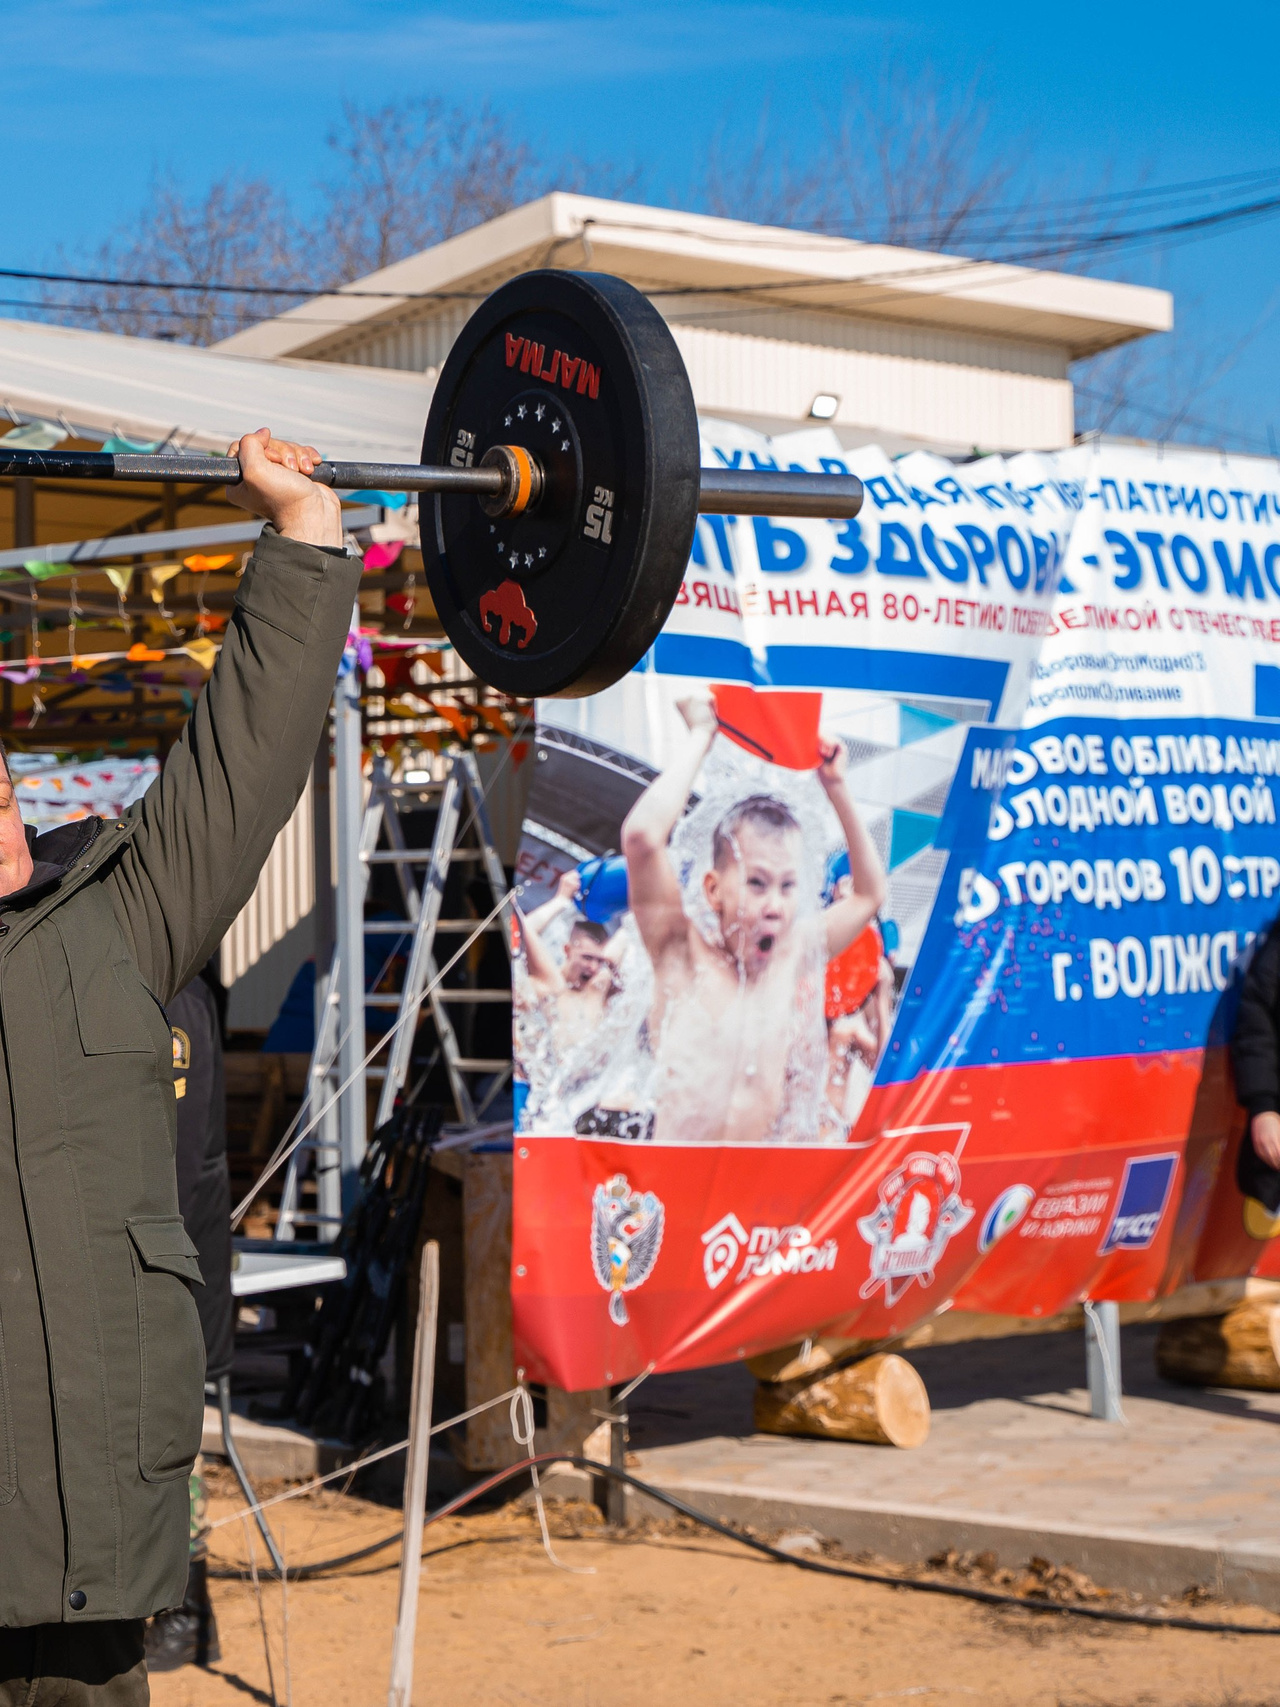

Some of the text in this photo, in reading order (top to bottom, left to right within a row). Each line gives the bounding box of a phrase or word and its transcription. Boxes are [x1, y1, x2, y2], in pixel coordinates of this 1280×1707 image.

[505, 332, 601, 400] МАГМА
[583, 503, 613, 545] 15
[593, 485, 615, 508] KG
[1162, 776, 1277, 832] ВОДОЙ
[999, 858, 1167, 909] ГОРОДОВ
[1169, 845, 1219, 906] 10
